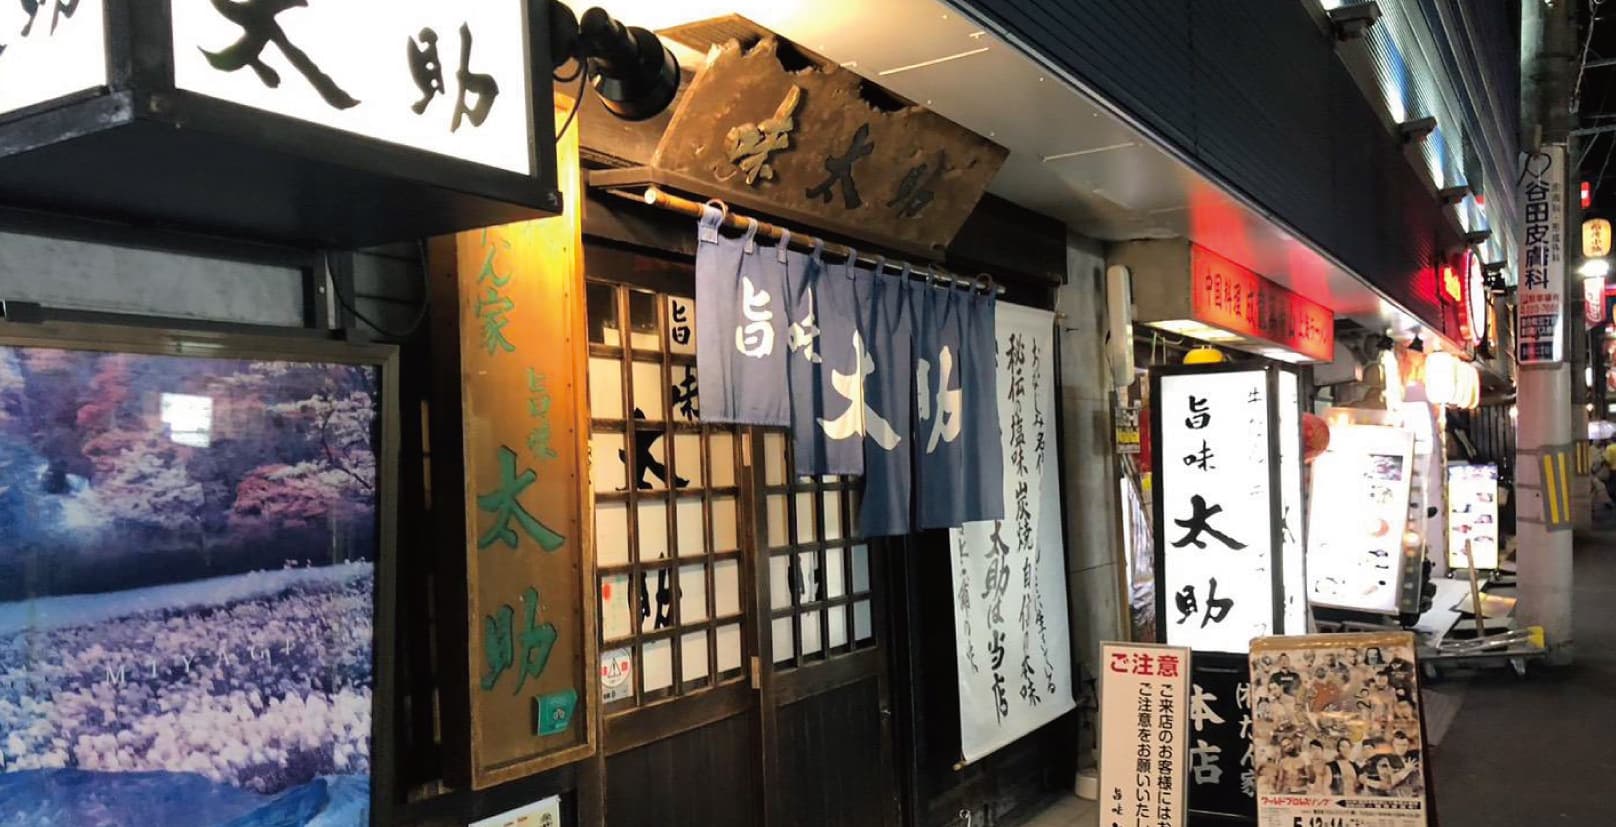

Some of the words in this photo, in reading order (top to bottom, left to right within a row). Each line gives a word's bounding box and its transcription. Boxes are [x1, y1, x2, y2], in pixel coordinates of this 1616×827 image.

[197, 0, 499, 133] 太助
[1525, 181, 1549, 290] 谷田皮膚科
[476, 445, 566, 696] 太助
[1110, 653, 1180, 678] ご注意
